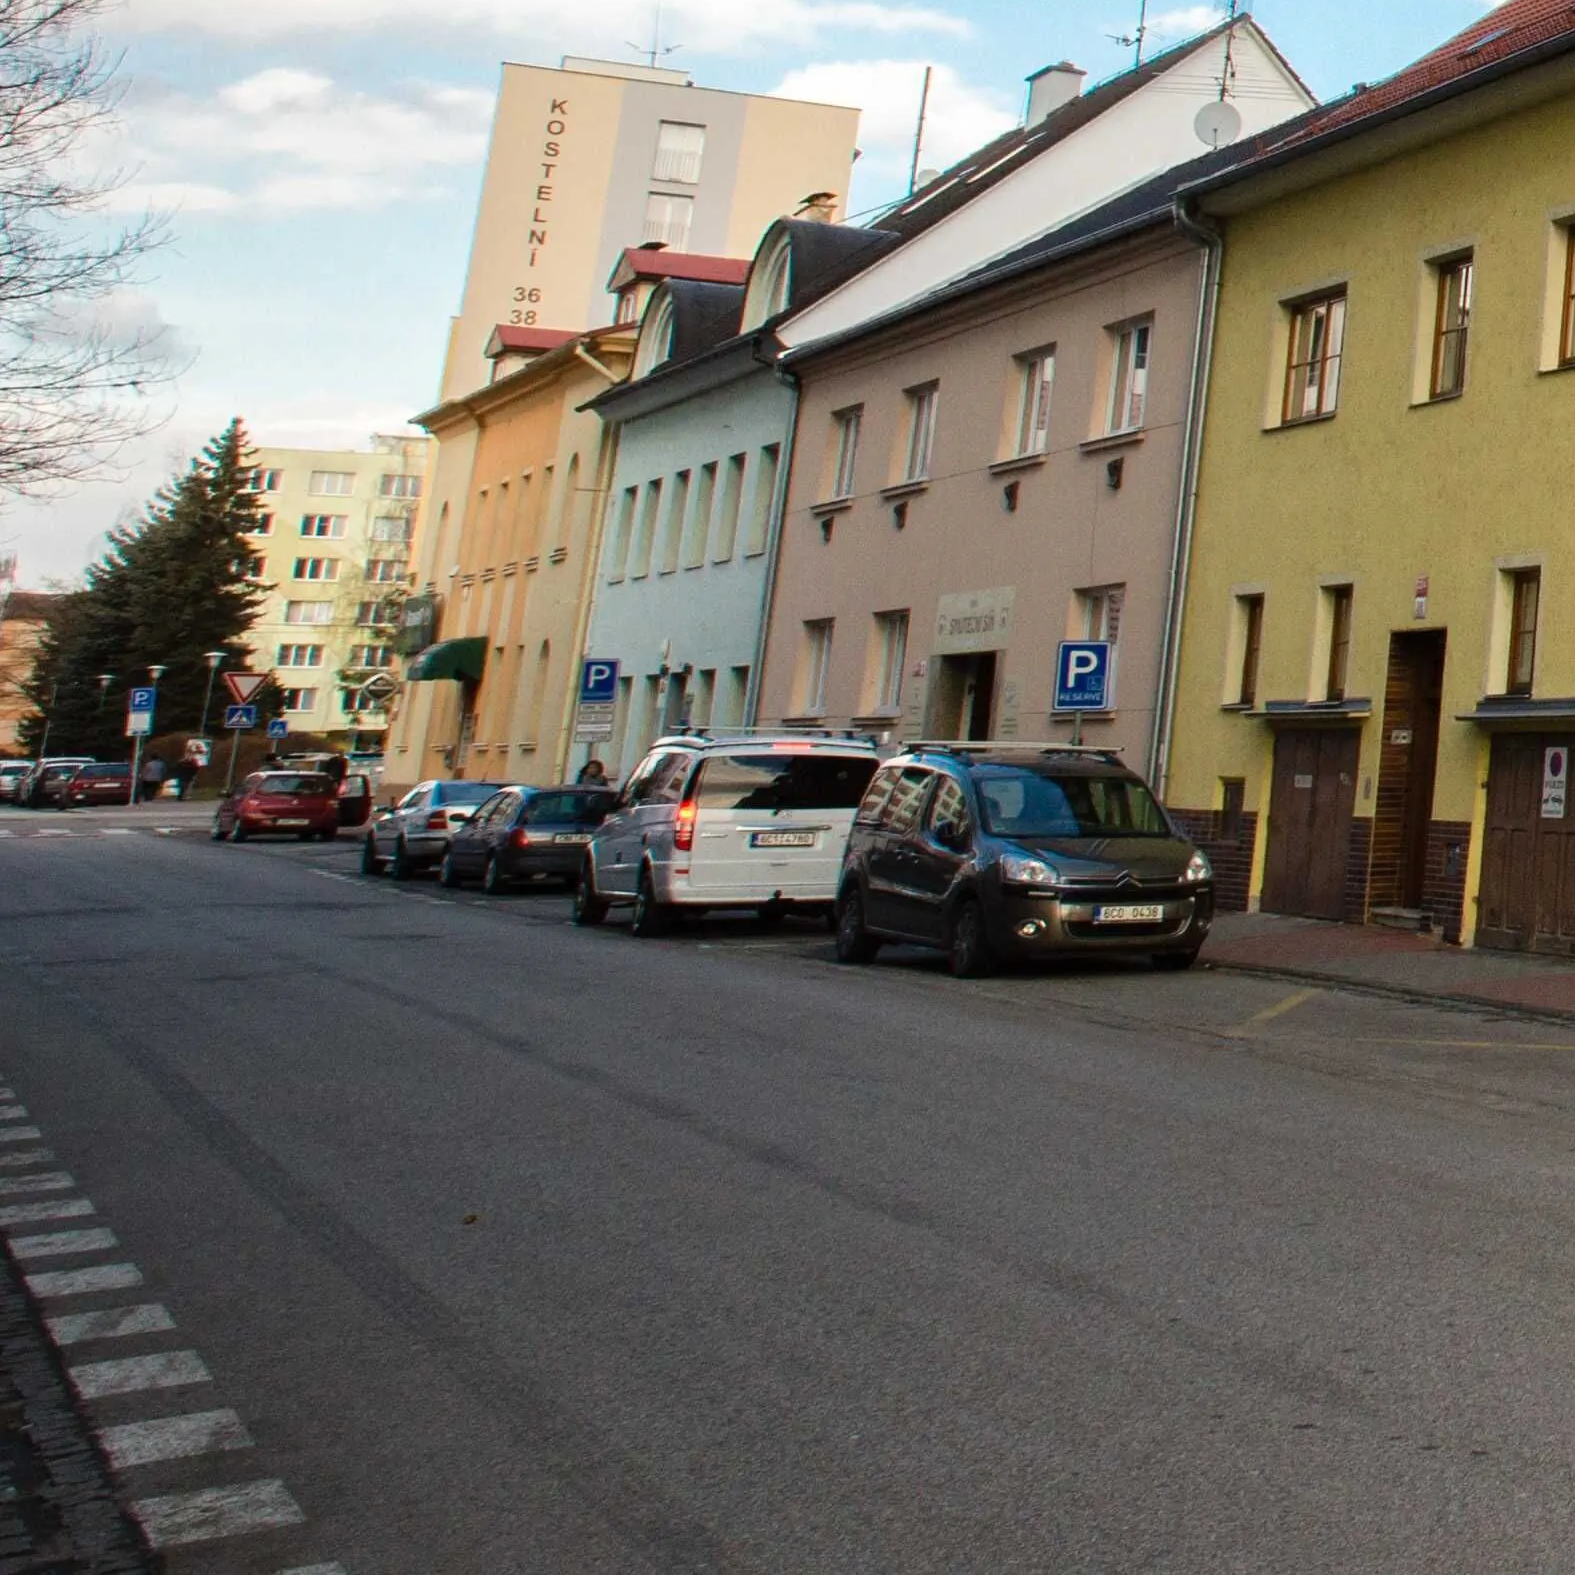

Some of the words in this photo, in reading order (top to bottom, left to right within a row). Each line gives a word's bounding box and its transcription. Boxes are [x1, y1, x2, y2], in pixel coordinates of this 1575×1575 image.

[528, 98, 569, 267] KOSTELNÍ
[513, 286, 541, 304] 36
[509, 309, 537, 326] 38
[588, 665, 610, 689] P
[1067, 650, 1098, 688] P
[134, 691, 148, 705] P
